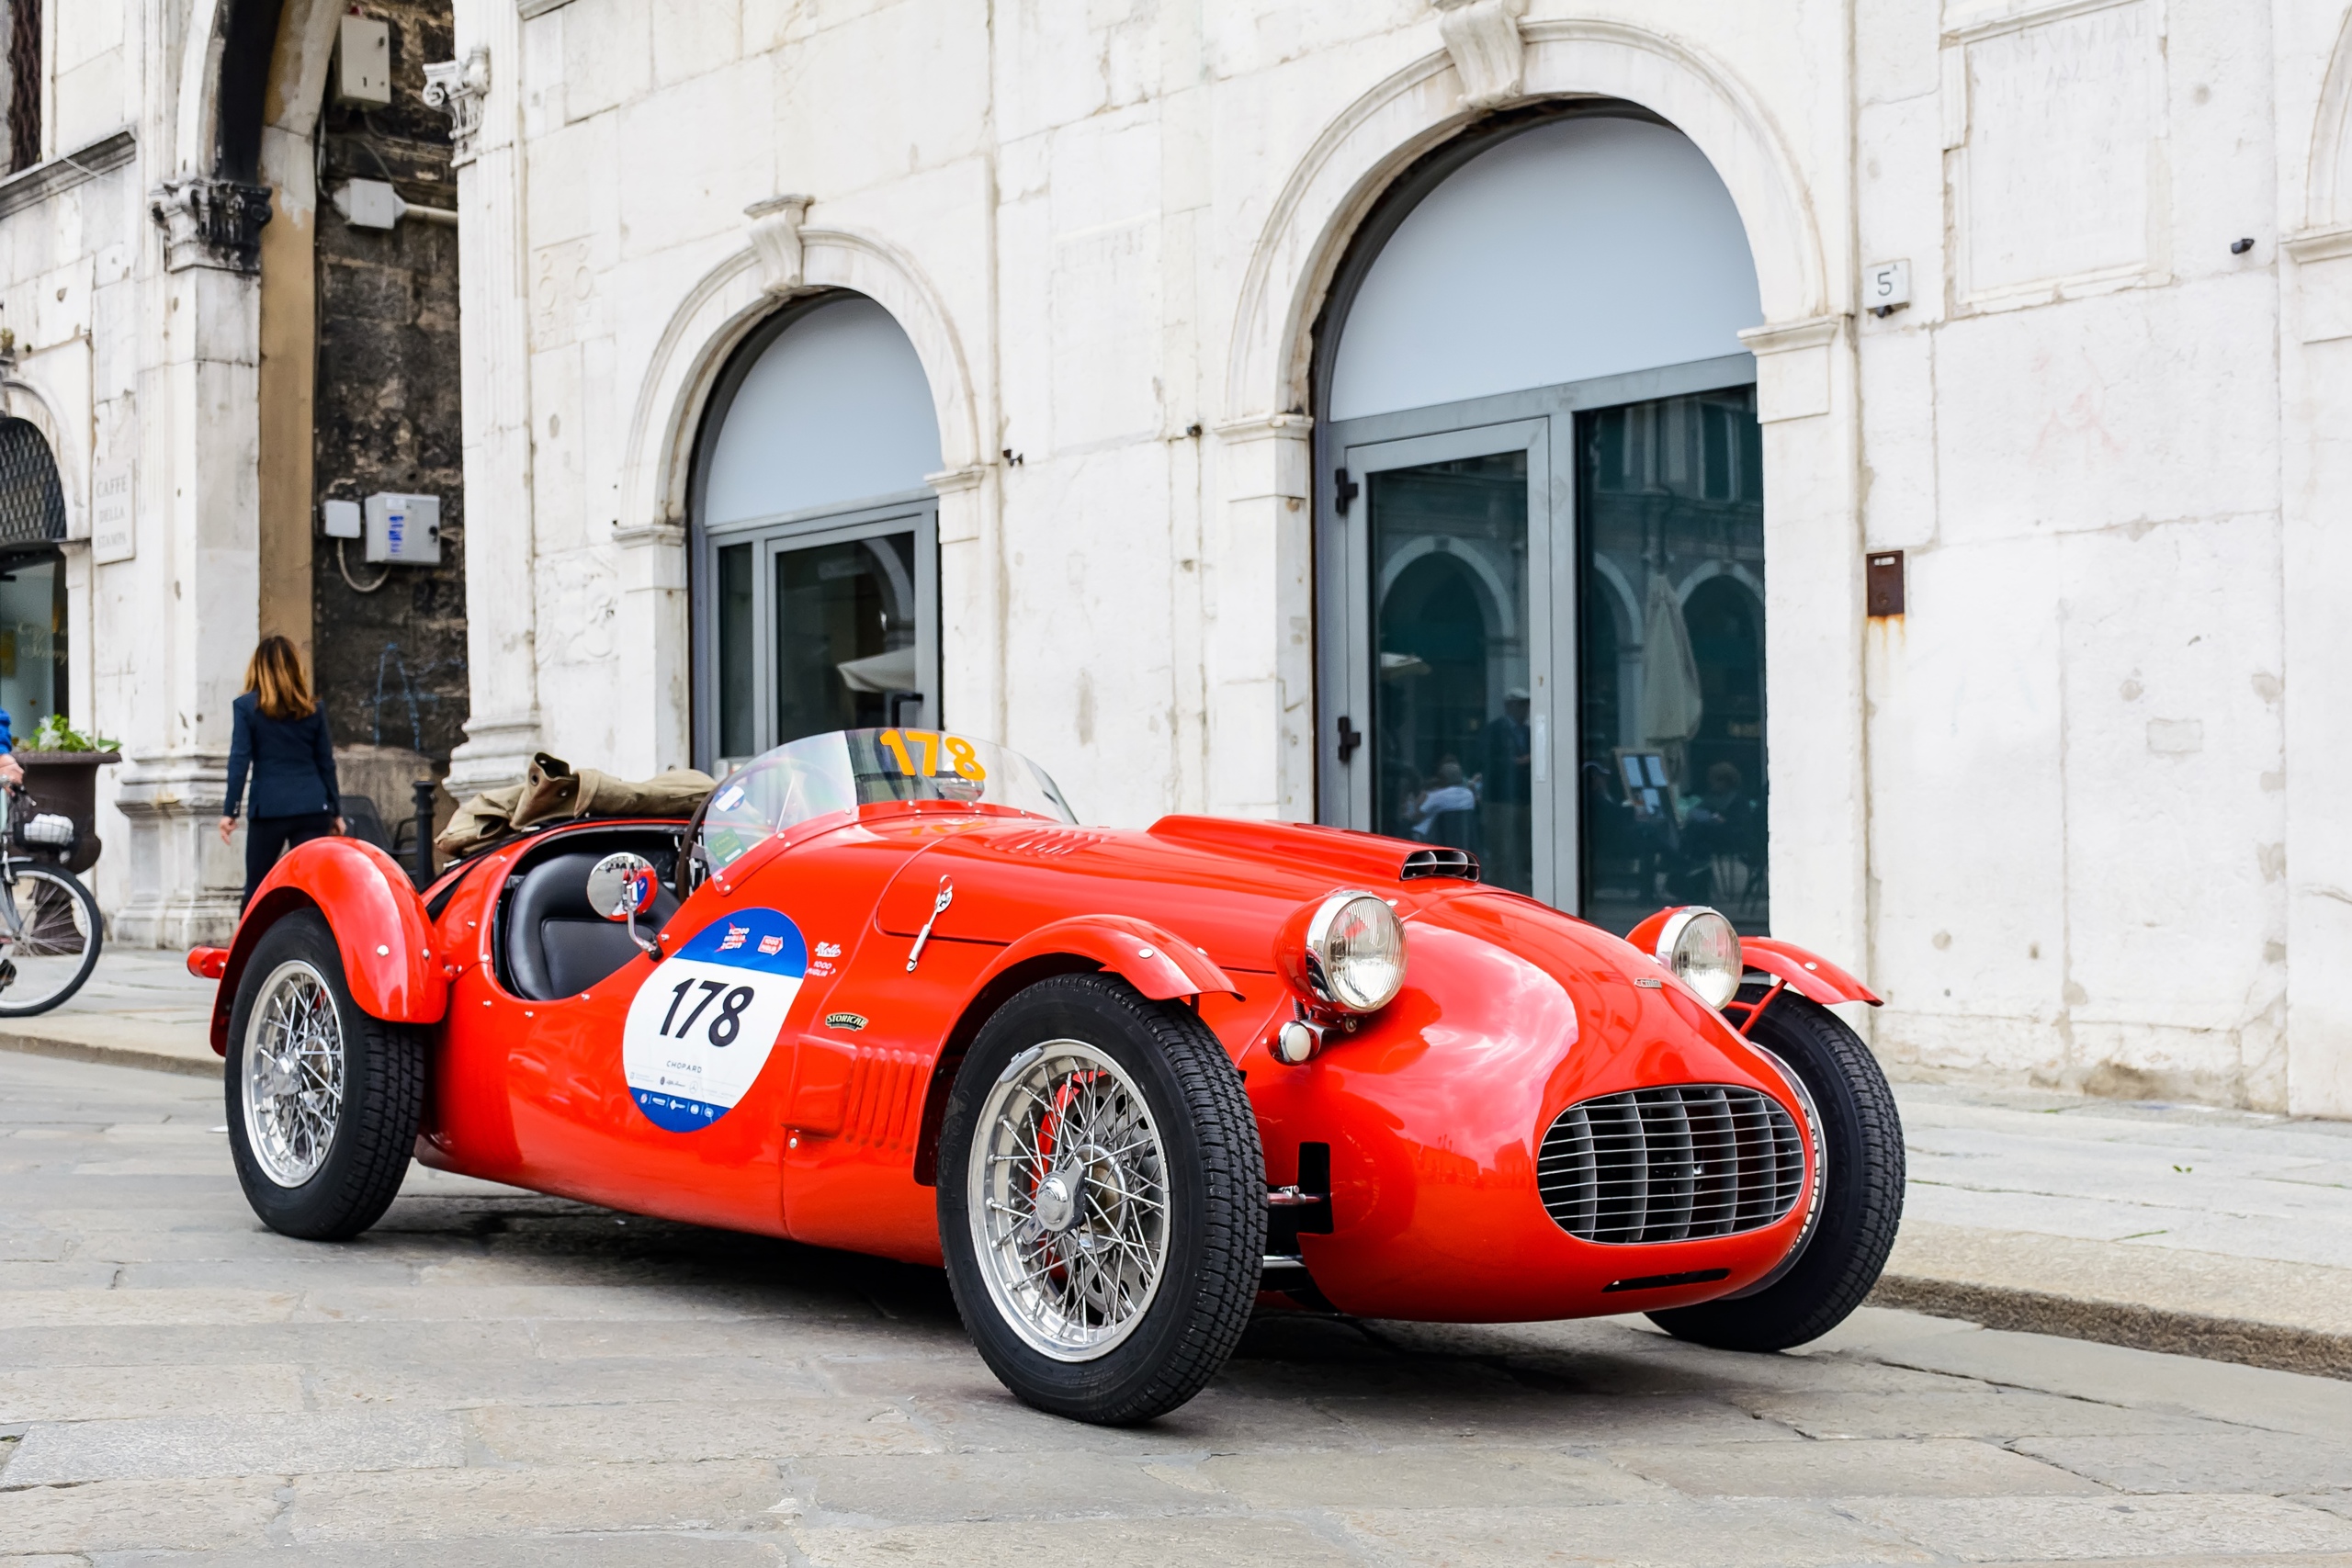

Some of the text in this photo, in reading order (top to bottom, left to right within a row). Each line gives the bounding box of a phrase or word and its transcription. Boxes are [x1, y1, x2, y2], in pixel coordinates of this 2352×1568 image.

[1877, 271, 1893, 297] 5
[98, 505, 125, 524] DELLA
[879, 728, 987, 782] 178
[813, 960, 832, 970] 1000
[659, 978, 755, 1047] 178
[827, 1014, 868, 1028] STORICAR
[666, 1060, 703, 1074] CHOPARD
